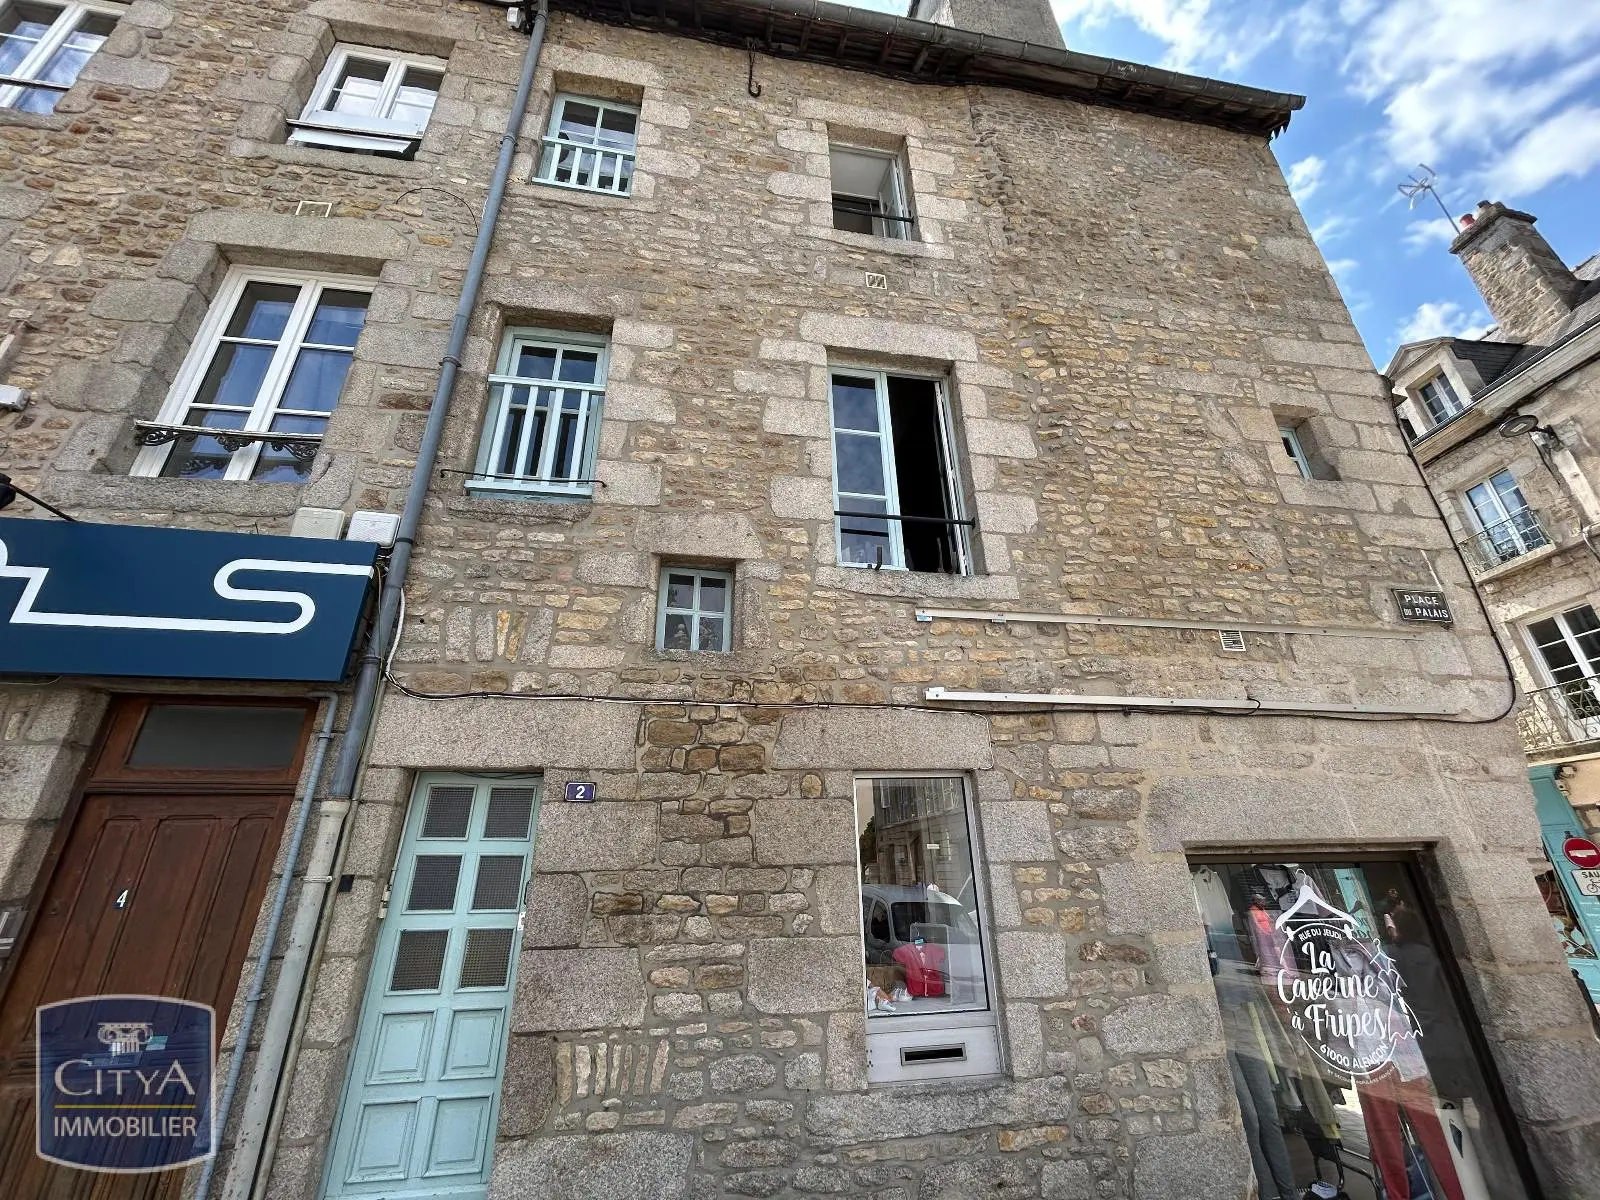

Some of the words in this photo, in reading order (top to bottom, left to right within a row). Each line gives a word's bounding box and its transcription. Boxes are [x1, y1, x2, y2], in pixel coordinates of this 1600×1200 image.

[1404, 595, 1439, 605] PLACE
[1415, 607, 1449, 618] PALAIS
[576, 785, 586, 799] 2
[116, 889, 129, 908] 4
[1298, 930, 1311, 941] RUE
[1310, 928, 1321, 936] DU
[1323, 929, 1342, 940] JEUDI
[1302, 941, 1336, 974] La
[1277, 968, 1379, 1005] Caverne
[1304, 1003, 1387, 1049] Fripes
[1319, 1043, 1350, 1067] 61000
